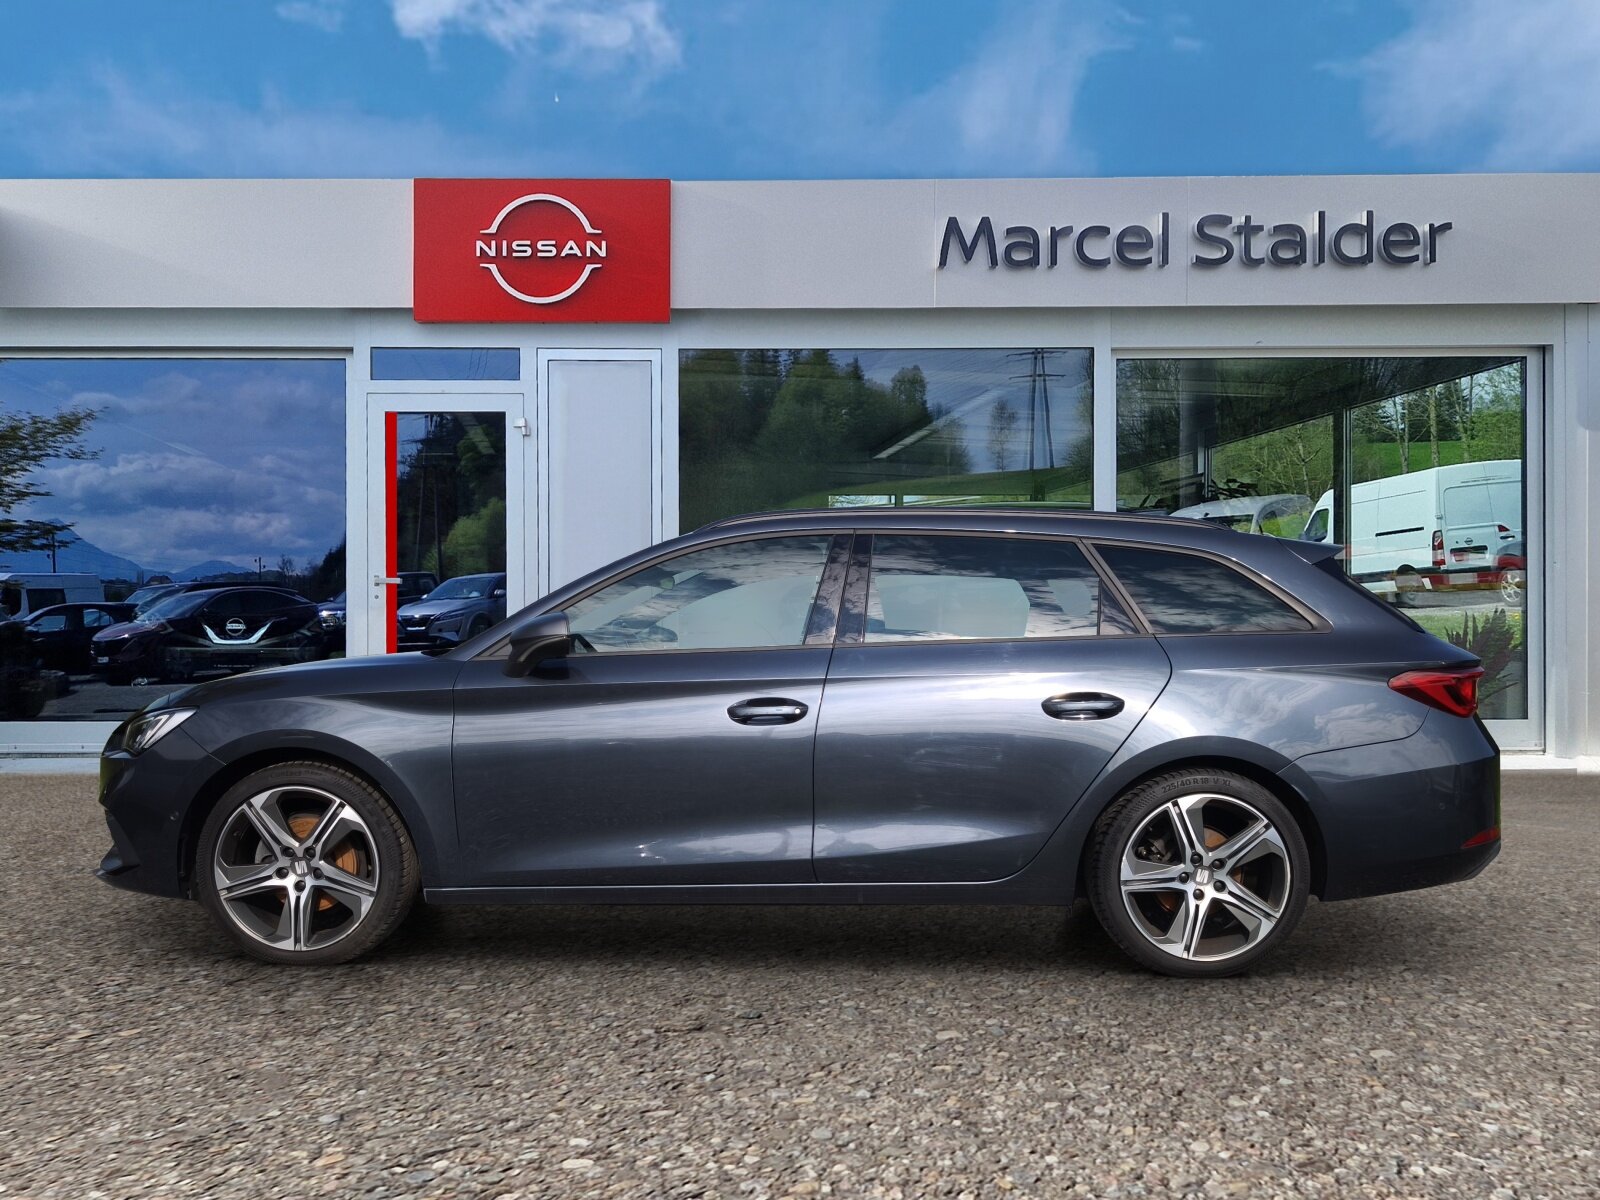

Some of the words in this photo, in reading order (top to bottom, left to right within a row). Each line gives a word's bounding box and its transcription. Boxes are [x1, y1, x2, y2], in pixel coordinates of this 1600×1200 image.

[475, 239, 607, 258] NISSAN
[938, 212, 1170, 269] Marcel
[1191, 210, 1453, 266] Stalder
[1161, 779, 1191, 793] 225/40
[1192, 777, 1199, 785] R
[1200, 777, 1209, 785] 18
